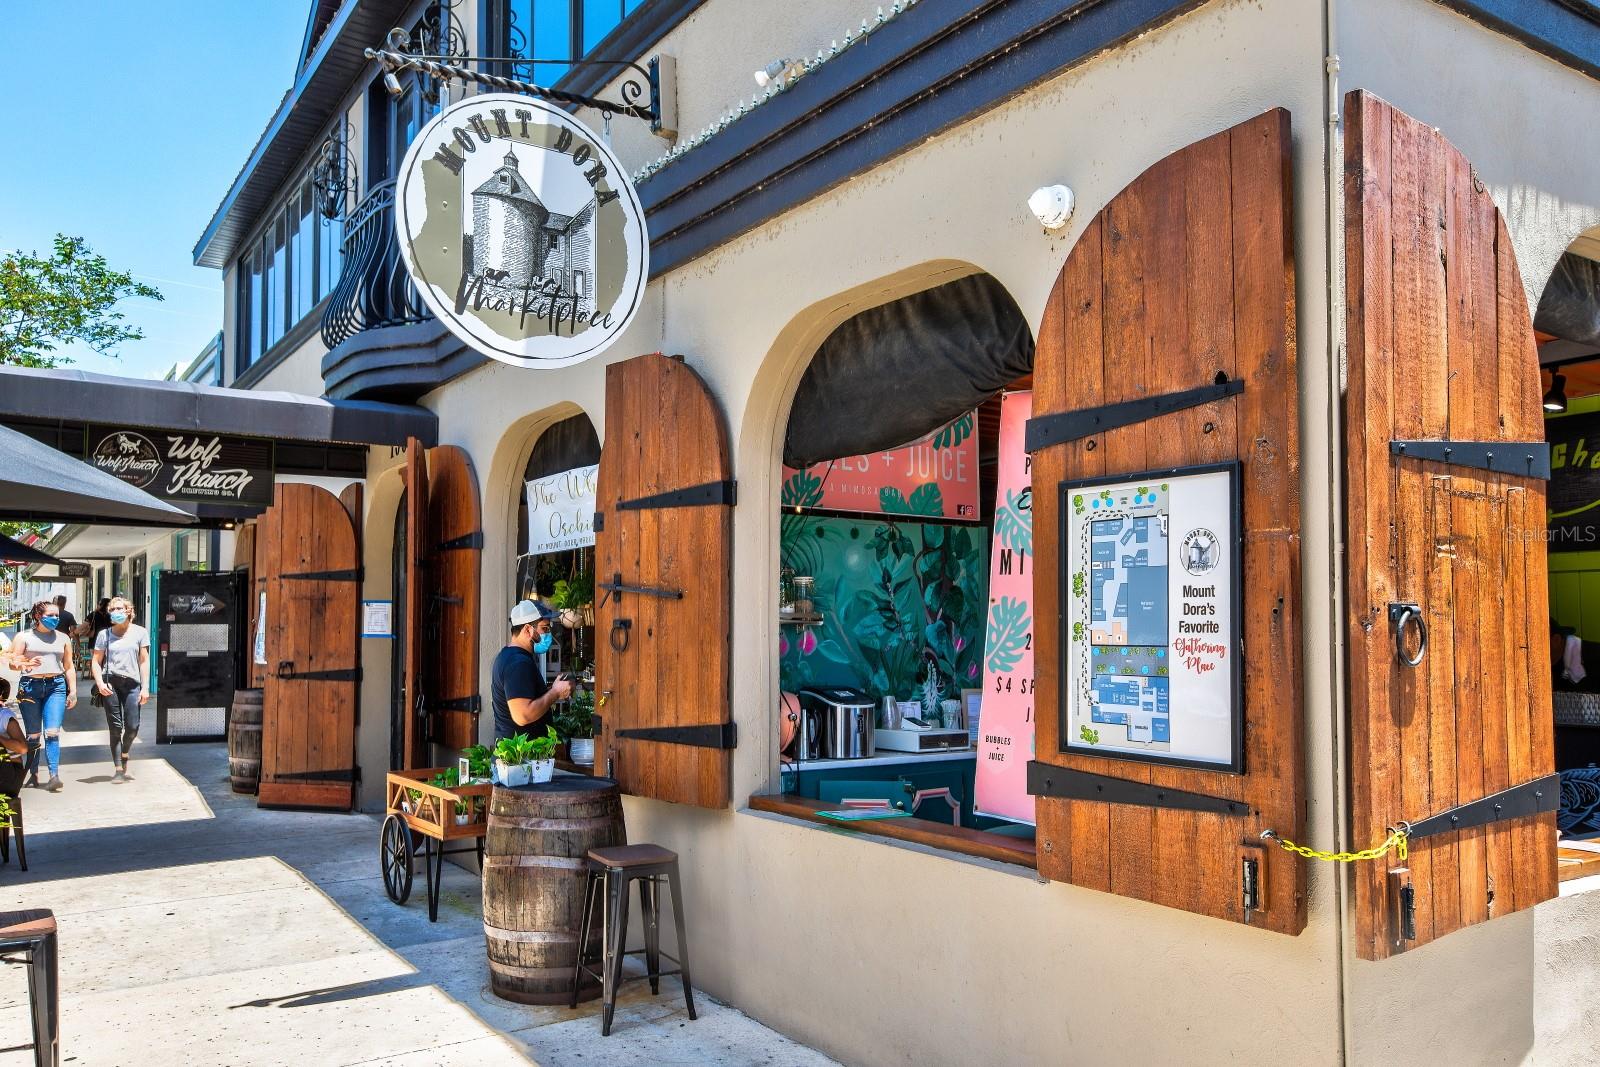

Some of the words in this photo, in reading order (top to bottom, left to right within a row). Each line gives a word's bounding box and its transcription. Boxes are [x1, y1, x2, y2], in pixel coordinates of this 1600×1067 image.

[434, 108, 532, 177] MOUNT
[554, 125, 620, 207] DORA
[455, 271, 615, 336] Marketplace
[167, 436, 222, 468] Wolf
[906, 446, 967, 483] JUICE
[166, 461, 253, 499] Branch
[1182, 584, 1216, 598] Mount
[1183, 602, 1216, 616] Dora's
[1178, 620, 1220, 634] Favorite
[1172, 637, 1227, 659] Gathering
[1183, 656, 1216, 675] Place
[996, 676, 1012, 693] $4
[985, 735, 1011, 746] BUBBLES
[988, 752, 1005, 762] JUICE
